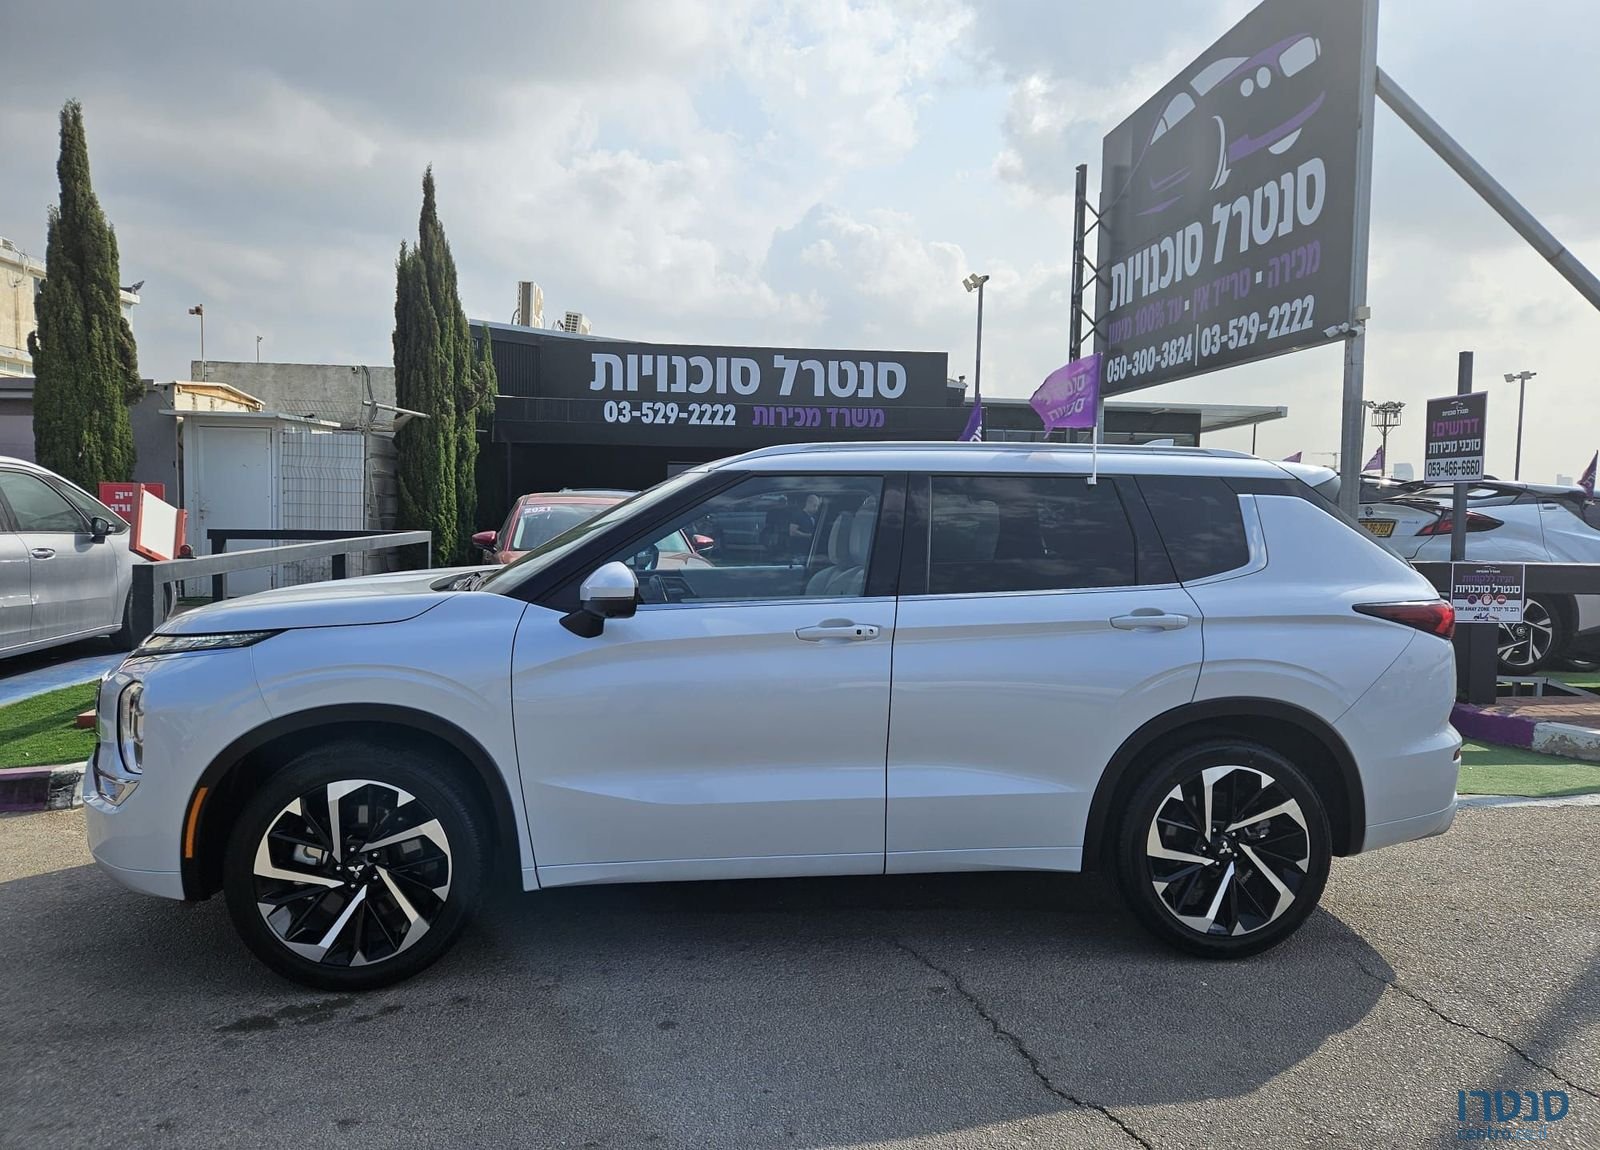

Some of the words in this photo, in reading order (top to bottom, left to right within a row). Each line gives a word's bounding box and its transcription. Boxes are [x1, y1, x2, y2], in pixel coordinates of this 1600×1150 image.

[1212, 157, 1326, 264] סנטרל
[1109, 222, 1204, 311] סוכנויות
[1268, 239, 1321, 289] מכירה
[1135, 299, 1165, 336] 100%
[1201, 294, 1315, 358] 03-529-2222
[1106, 333, 1193, 384] 050-300-3824
[590, 352, 761, 396] סוכנויות
[773, 354, 907, 399] סנטרל
[604, 400, 736, 427] 03-529-2222
[752, 404, 821, 427] מכירות
[827, 406, 885, 428] משרד
[1432, 417, 1479, 437] דרושים!
[1428, 440, 1457, 454] מכירות
[1459, 439, 1481, 452] סוכני
[1427, 460, 1480, 477] 053-466-6660
[115, 491, 133, 499] ייה
[110, 504, 131, 512] ורה
[524, 506, 552, 514] 2021
[1454, 584, 1491, 593] סוכנויות
[1492, 583, 1521, 594] סנטרל
